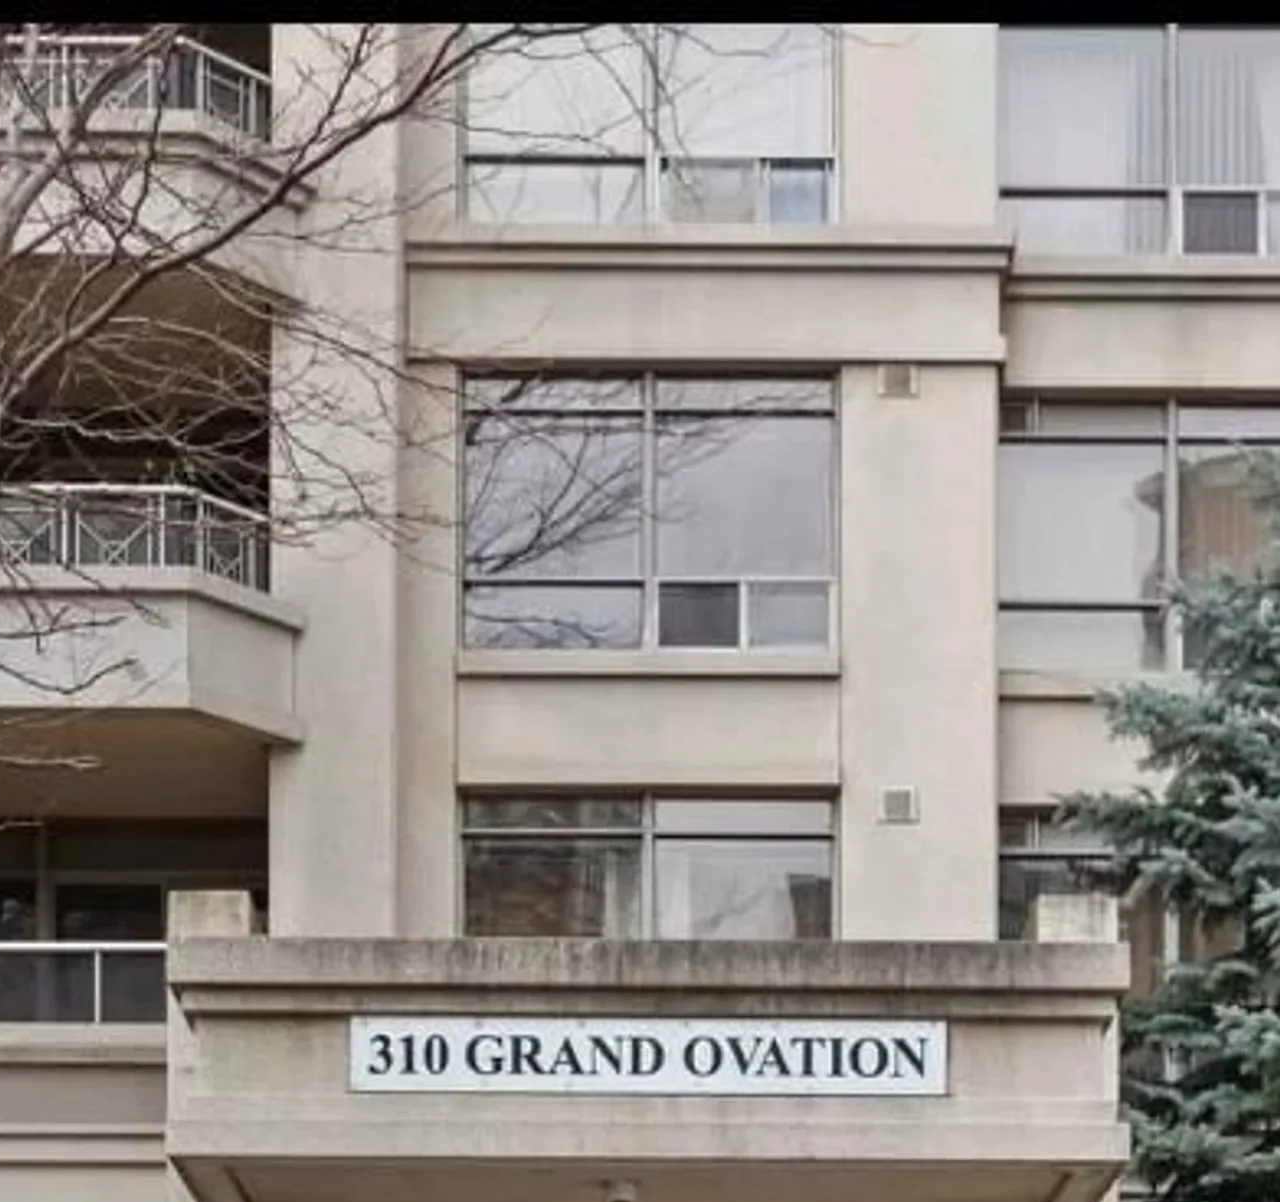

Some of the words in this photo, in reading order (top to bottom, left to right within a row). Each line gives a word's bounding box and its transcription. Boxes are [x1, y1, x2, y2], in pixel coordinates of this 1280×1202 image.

[367, 1033, 450, 1076] 310
[465, 1034, 666, 1077] GRAND
[683, 1034, 929, 1079] OVATION
